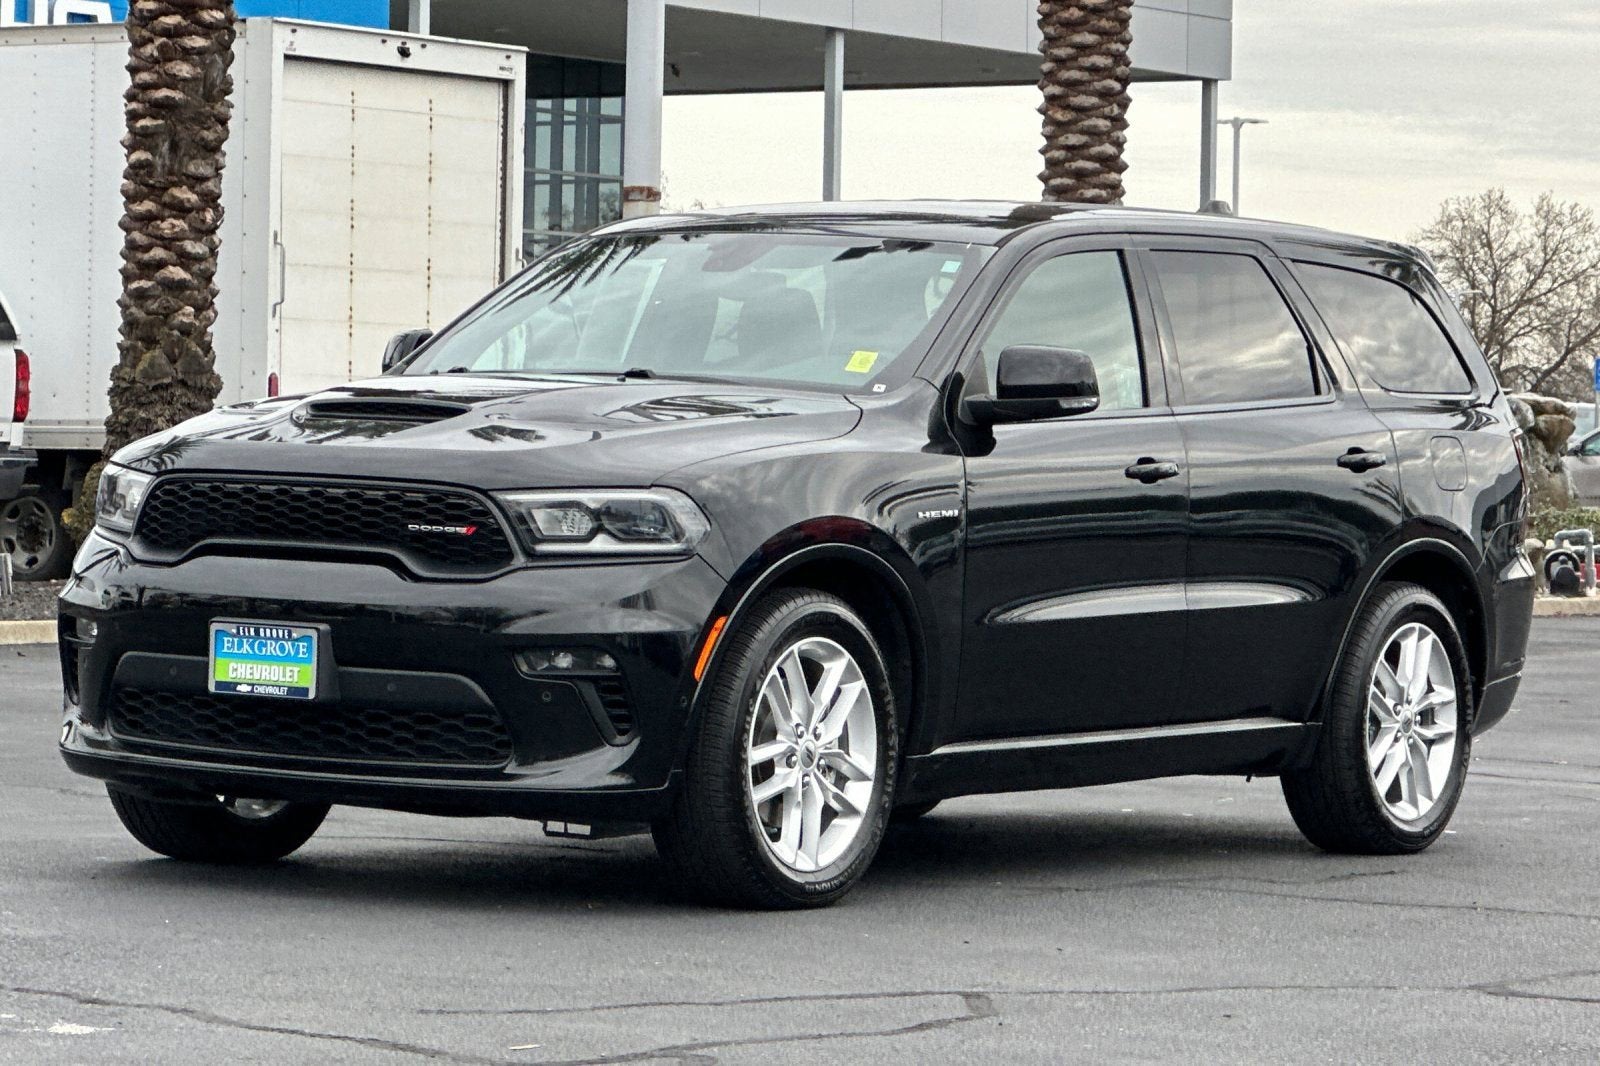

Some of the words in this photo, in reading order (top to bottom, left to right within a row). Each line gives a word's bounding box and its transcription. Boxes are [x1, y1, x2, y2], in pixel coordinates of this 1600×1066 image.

[917, 509, 959, 519] HEMI
[407, 524, 467, 533] DODGE
[239, 626, 255, 637] ELK
[259, 627, 289, 639] GROVE
[228, 662, 301, 684] CHEVROLET
[253, 685, 288, 696] CHEVROLET
